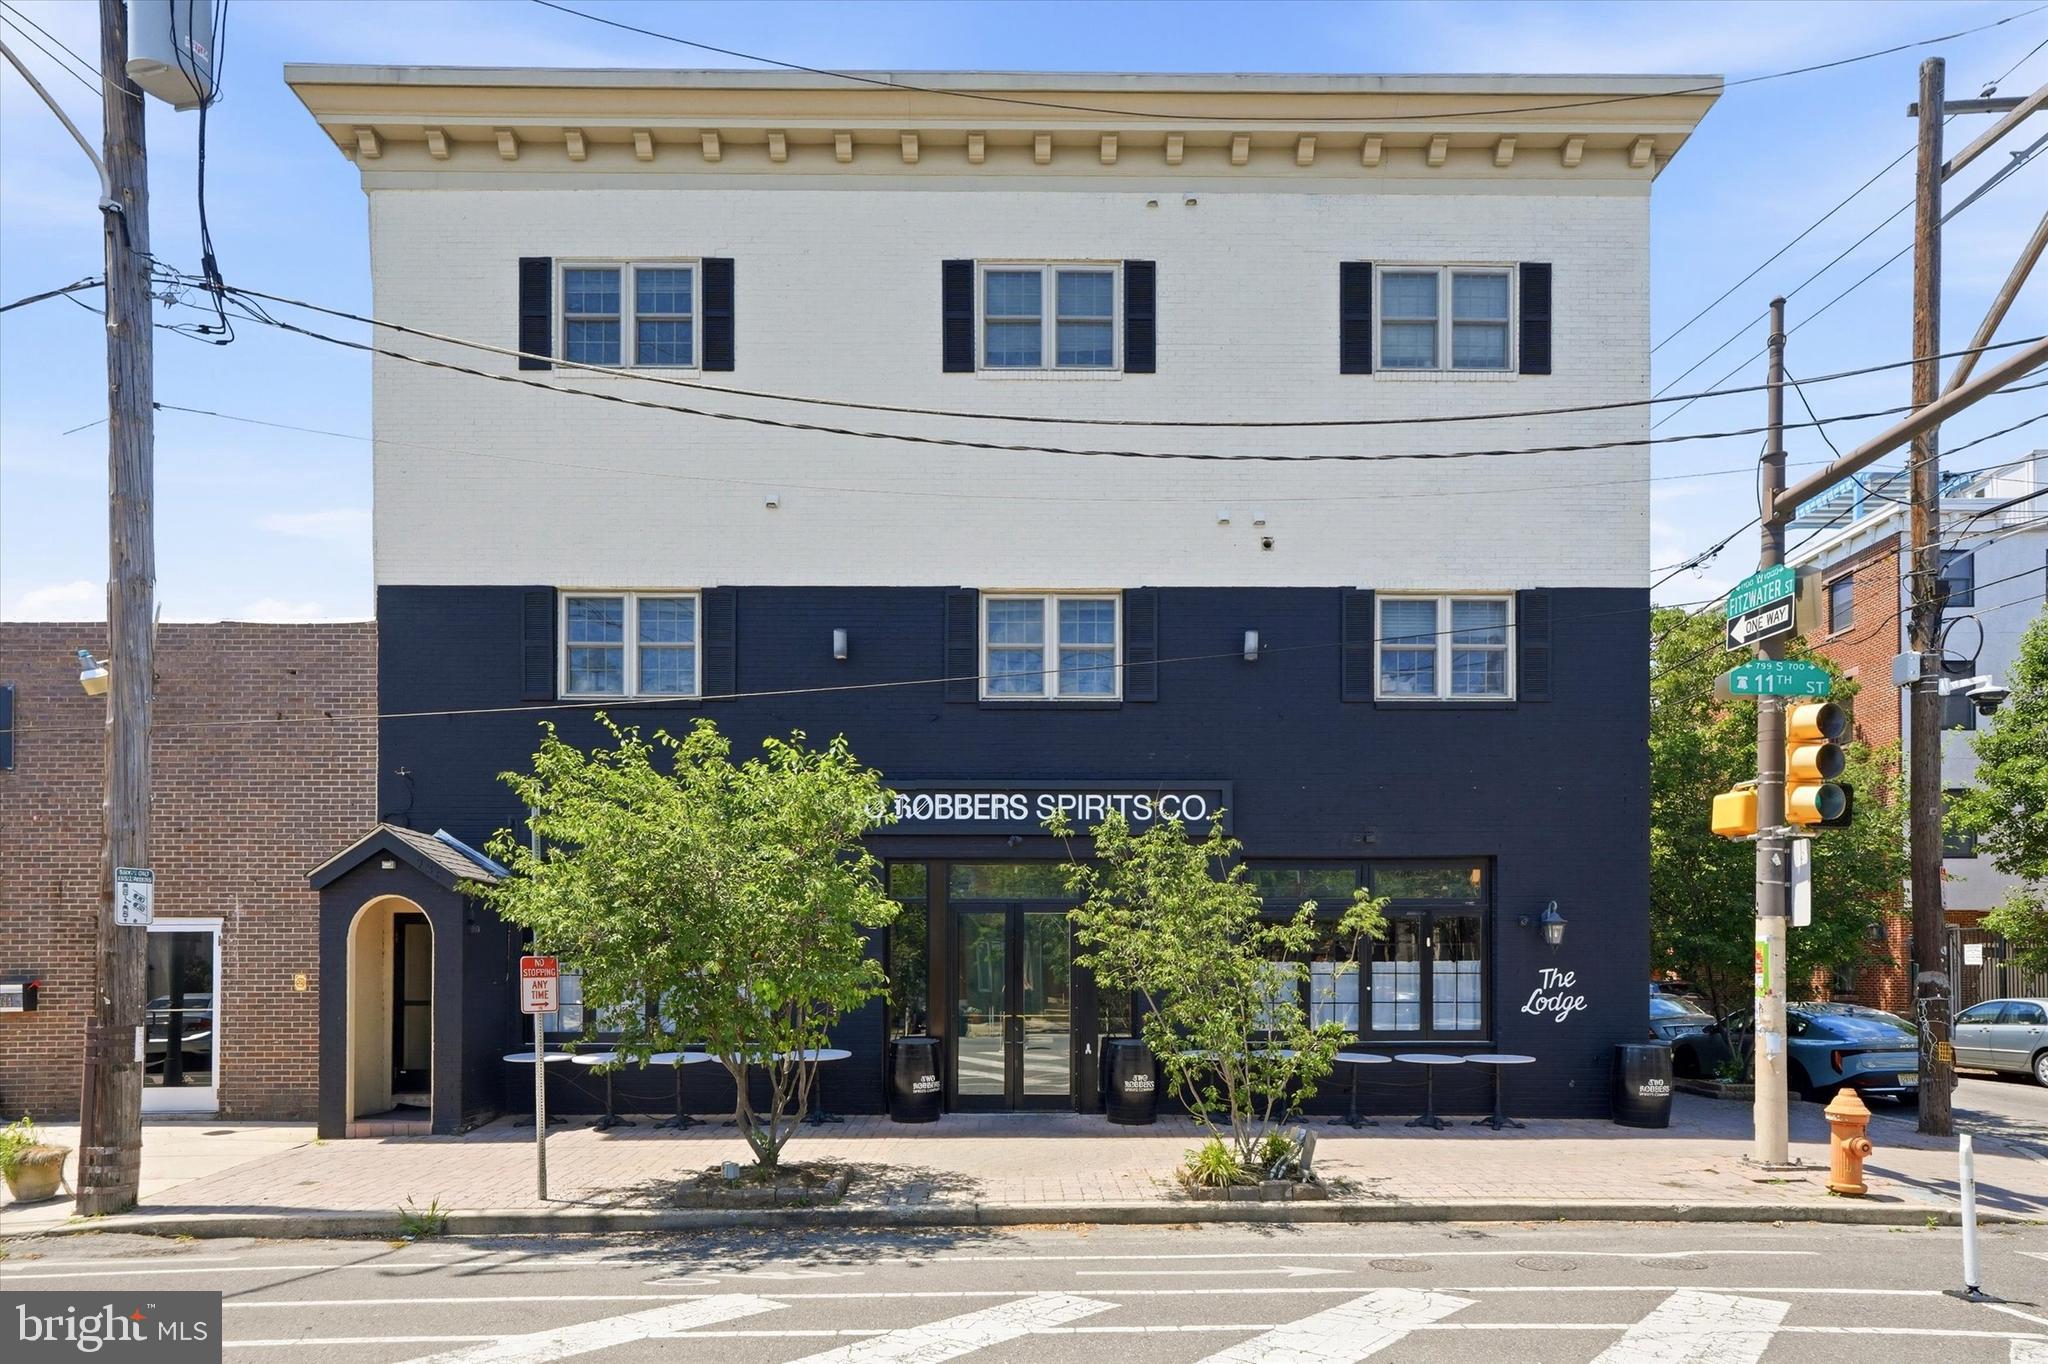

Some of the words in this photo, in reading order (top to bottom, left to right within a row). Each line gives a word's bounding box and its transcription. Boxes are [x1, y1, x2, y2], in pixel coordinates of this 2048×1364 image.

[1756, 574, 1764, 584] W
[1729, 579, 1781, 617] FITZWATER
[1784, 579, 1793, 594] ST
[1745, 616, 1764, 634] ONE
[1766, 607, 1787, 626] WAY
[1776, 662, 1784, 671] S
[1788, 663, 1805, 671] 700
[1755, 674, 1792, 692] 11TH
[1806, 681, 1825, 694] ST
[1036, 794, 1153, 820] SPIRITS
[1159, 794, 1211, 821] CO.
[534, 959, 545, 967] NO
[523, 968, 556, 977] STOPPING
[1538, 968, 1577, 990] The
[532, 980, 548, 989] ANY
[532, 990, 549, 999] TIME
[1521, 988, 1588, 1023] Lodge
